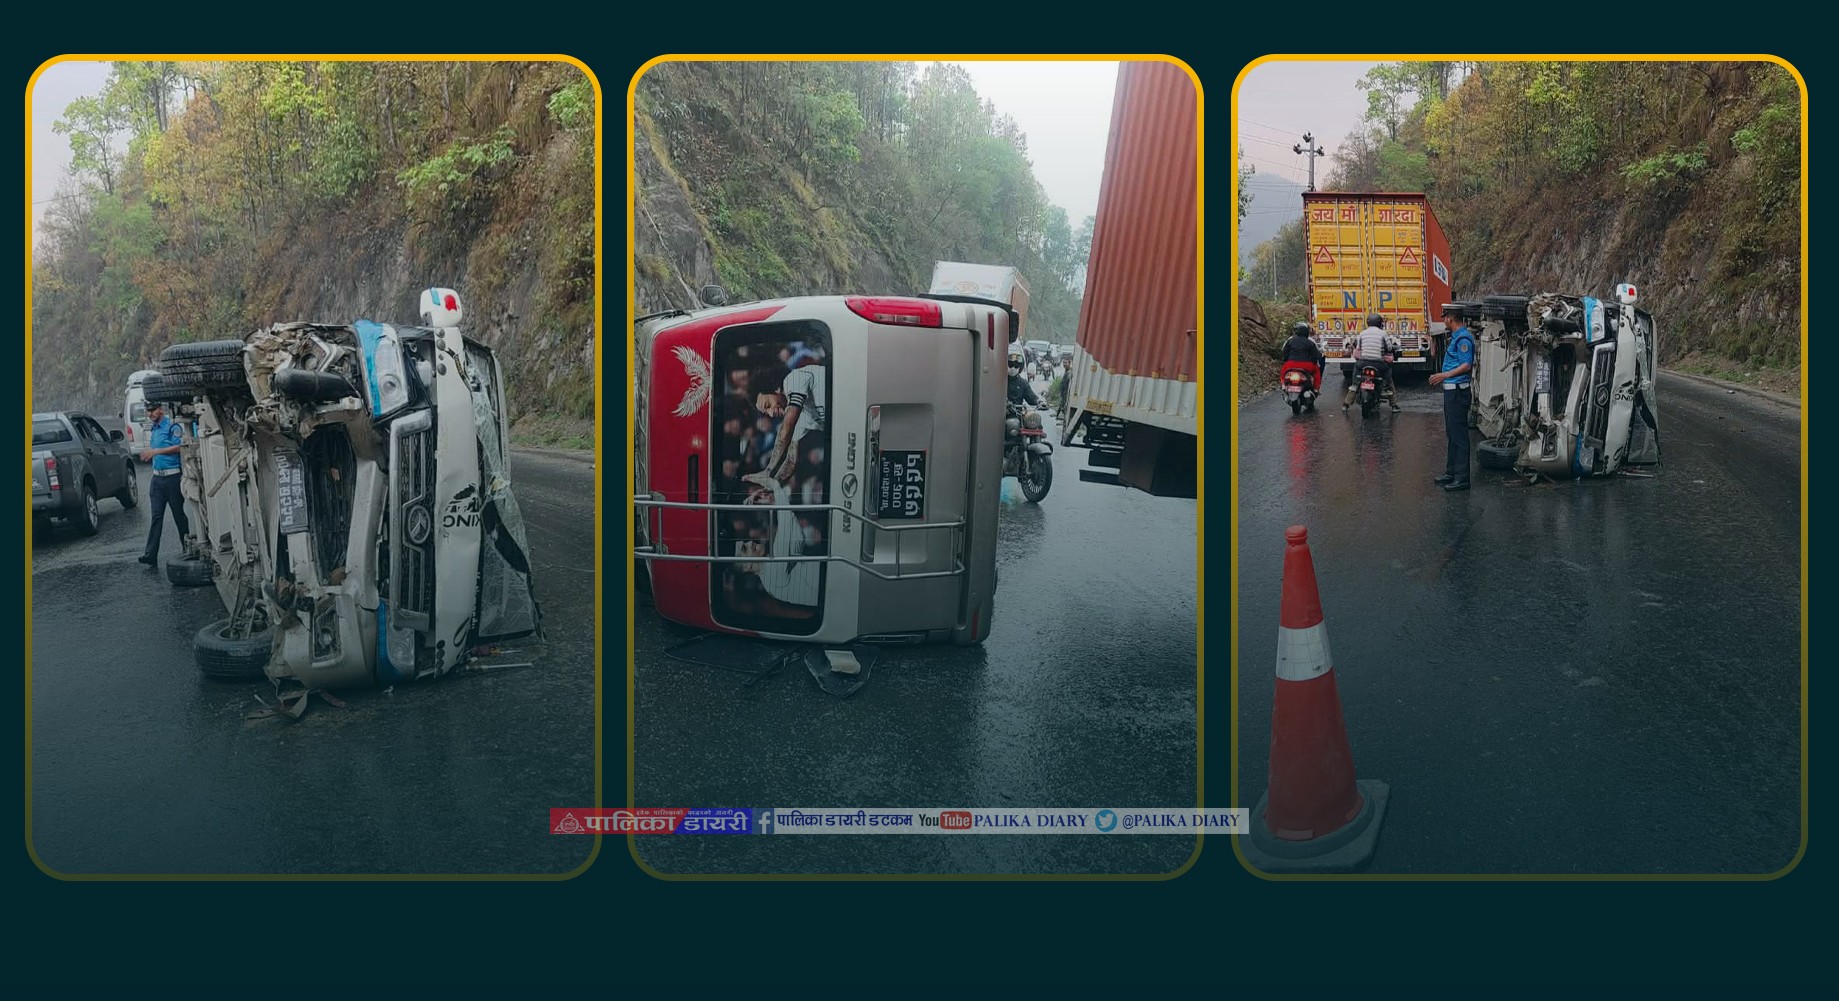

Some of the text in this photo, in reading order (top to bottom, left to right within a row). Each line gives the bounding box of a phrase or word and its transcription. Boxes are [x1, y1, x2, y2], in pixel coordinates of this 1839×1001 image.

[1312, 208, 1334, 221] जय
[1343, 291, 1358, 309] N
[1378, 291, 1393, 309] P
[1318, 320, 1358, 331] BLOW
